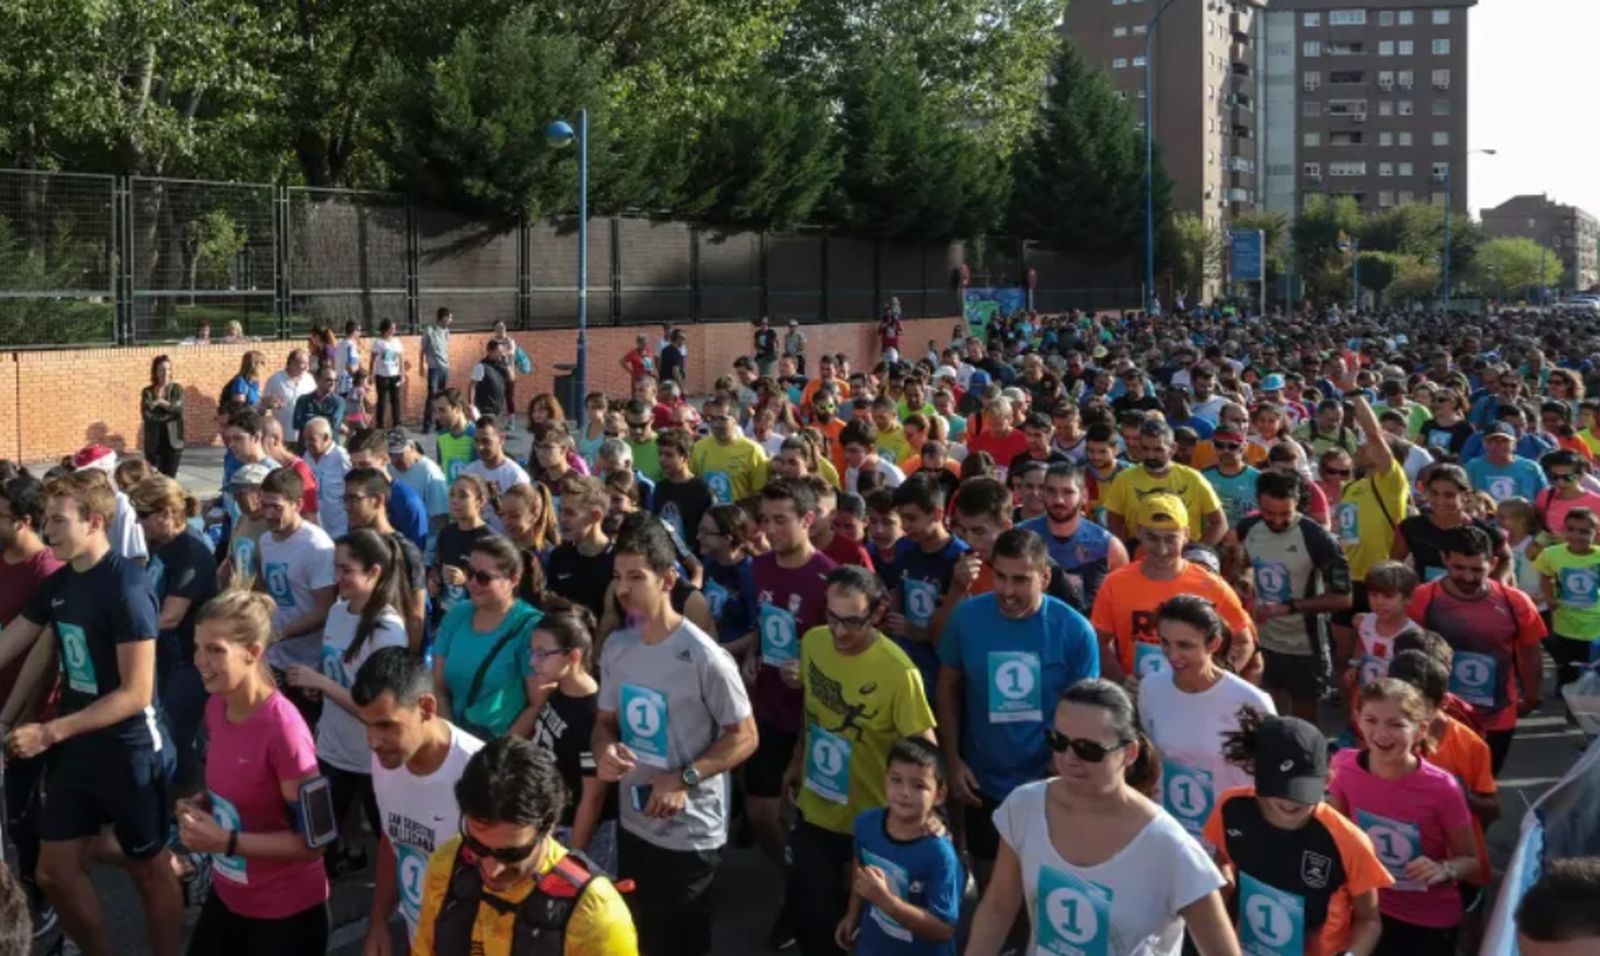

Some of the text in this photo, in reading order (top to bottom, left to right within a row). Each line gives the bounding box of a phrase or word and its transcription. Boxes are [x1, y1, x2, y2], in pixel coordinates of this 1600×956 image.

[1263, 571, 1278, 590] 1
[914, 593, 926, 612] 1
[771, 621, 783, 641] 1
[1006, 665, 1023, 693] 1
[1465, 663, 1479, 682] 1
[635, 703, 650, 731] 1
[820, 746, 833, 771] 1
[1178, 782, 1195, 810] 1
[1375, 832, 1399, 860] 1
[408, 864, 420, 898] 1
[1061, 898, 1082, 936] 1
[1256, 904, 1277, 939] 1
